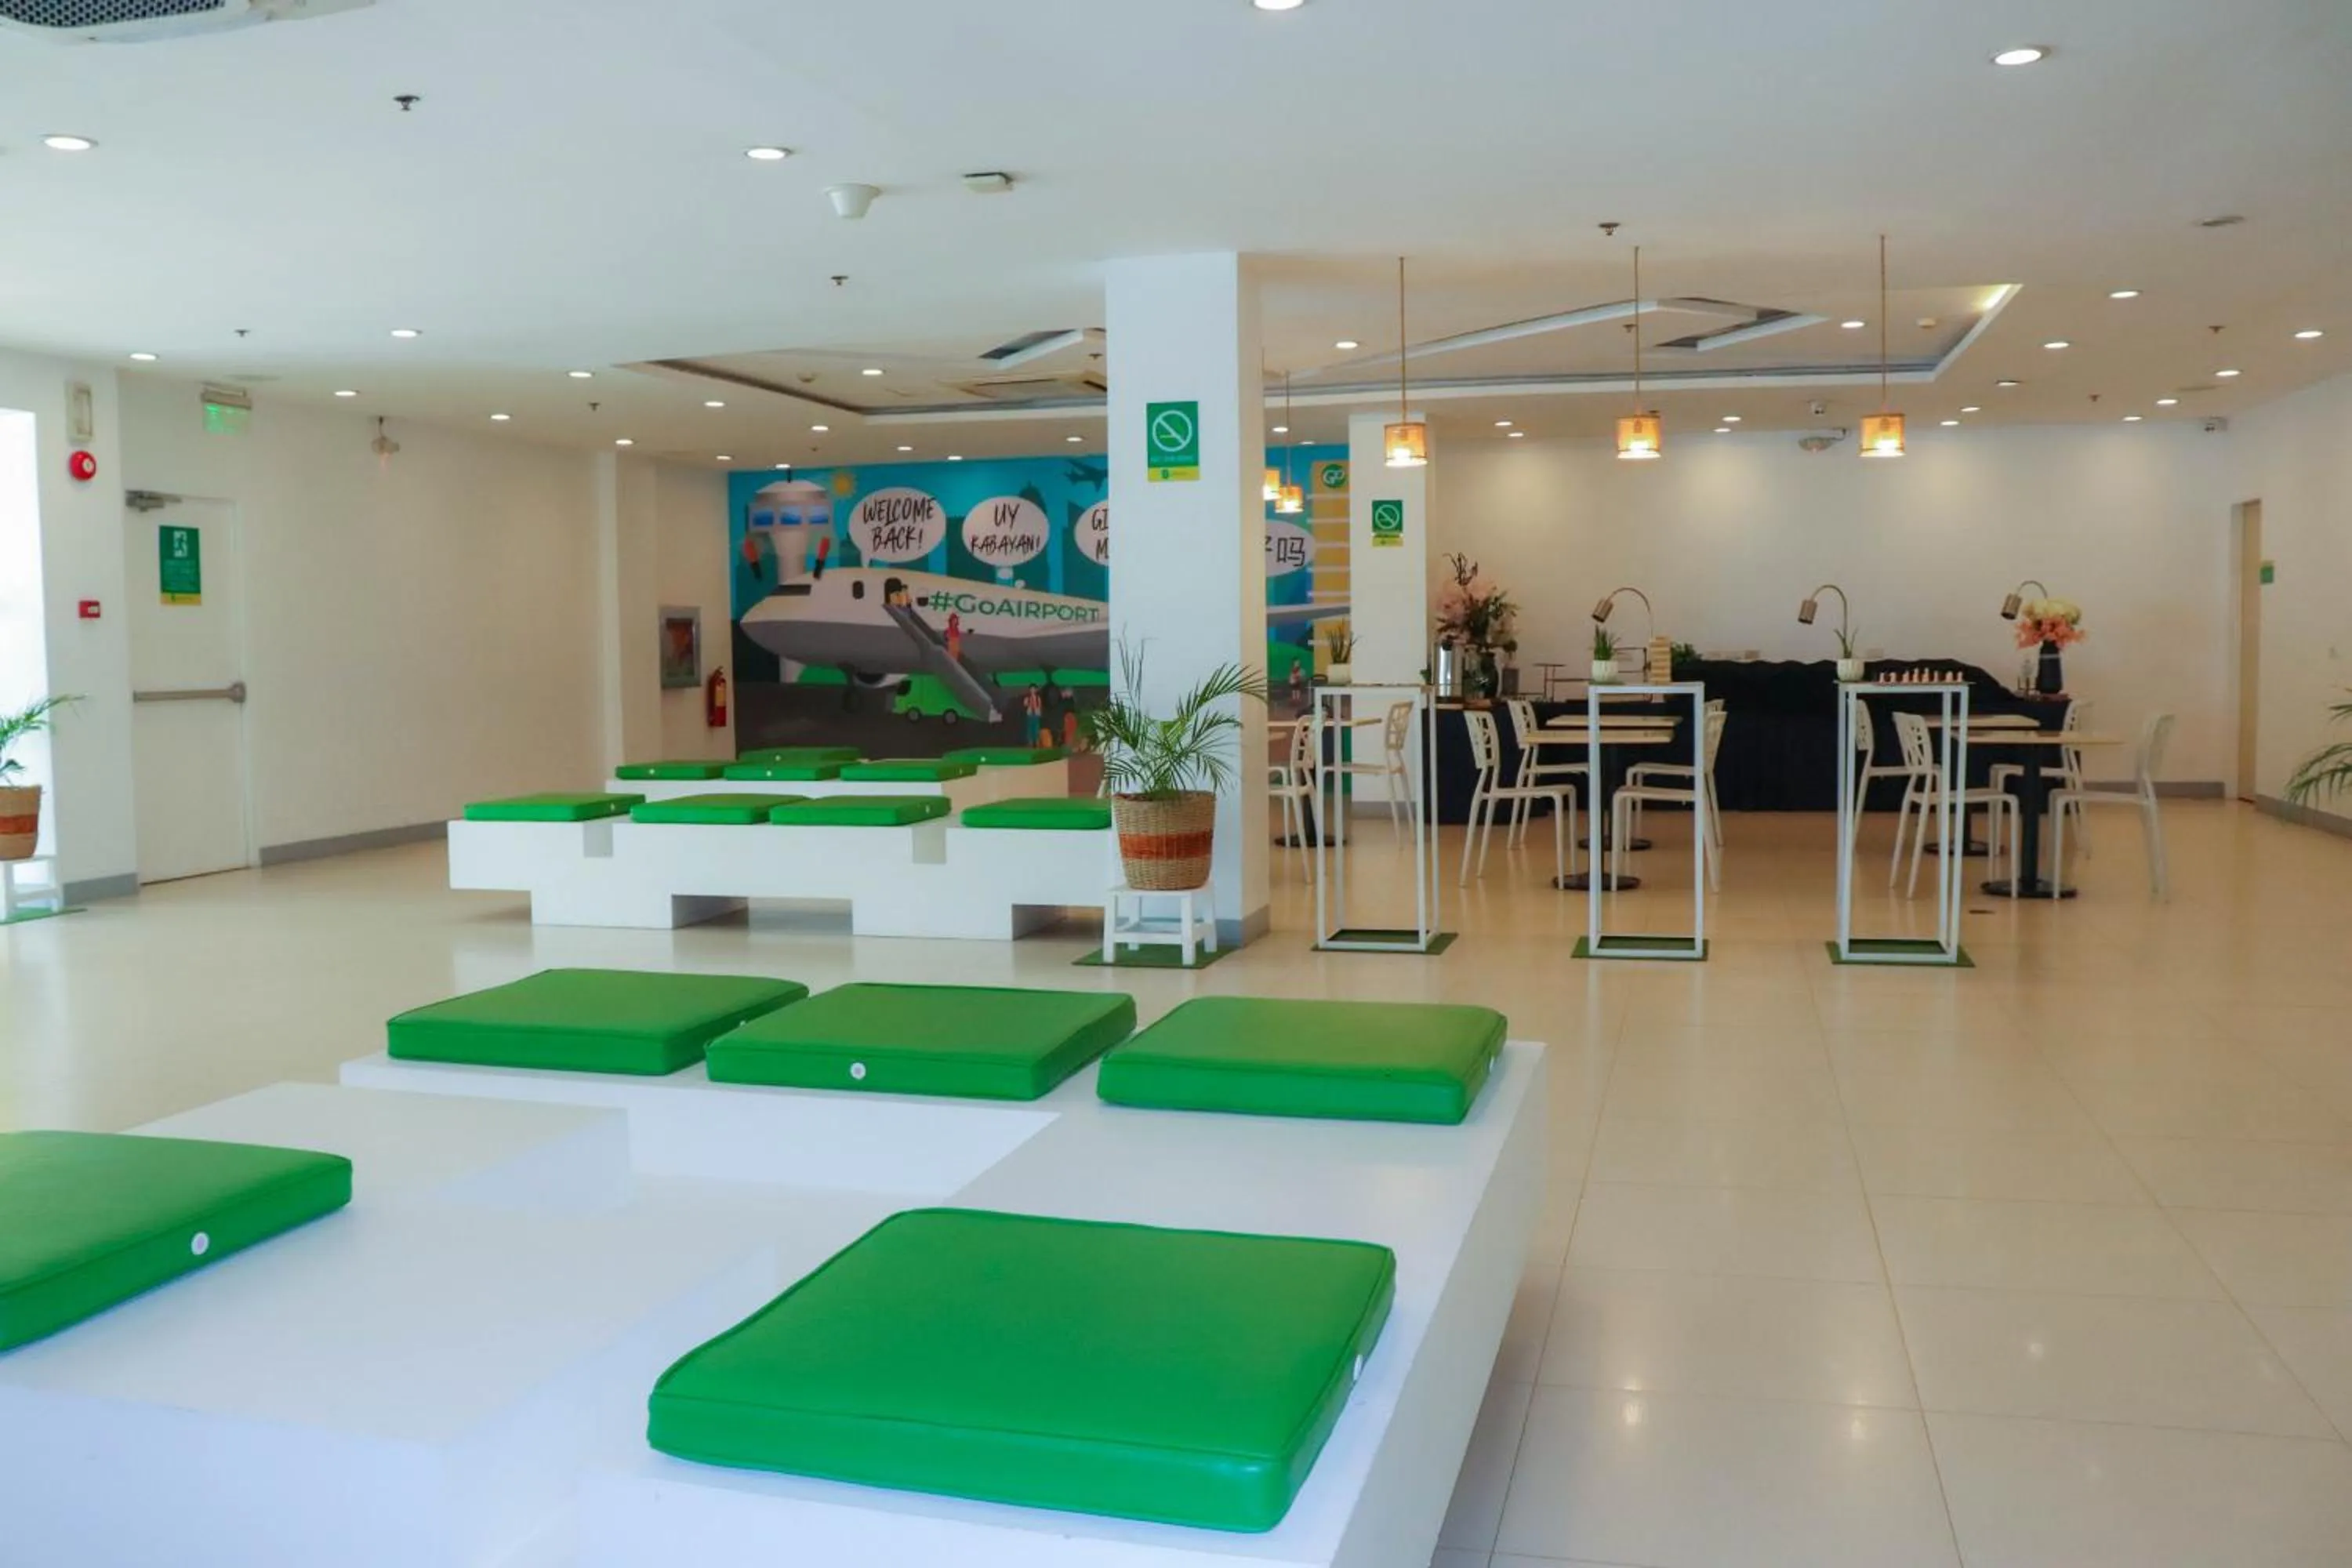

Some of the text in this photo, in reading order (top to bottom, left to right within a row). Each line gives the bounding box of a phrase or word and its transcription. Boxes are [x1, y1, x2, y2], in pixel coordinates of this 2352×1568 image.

[863, 497, 936, 526] WELCOME
[994, 503, 1020, 532] UY
[872, 525, 923, 553] BACK!
[971, 535, 1040, 556] KABAYAN!
